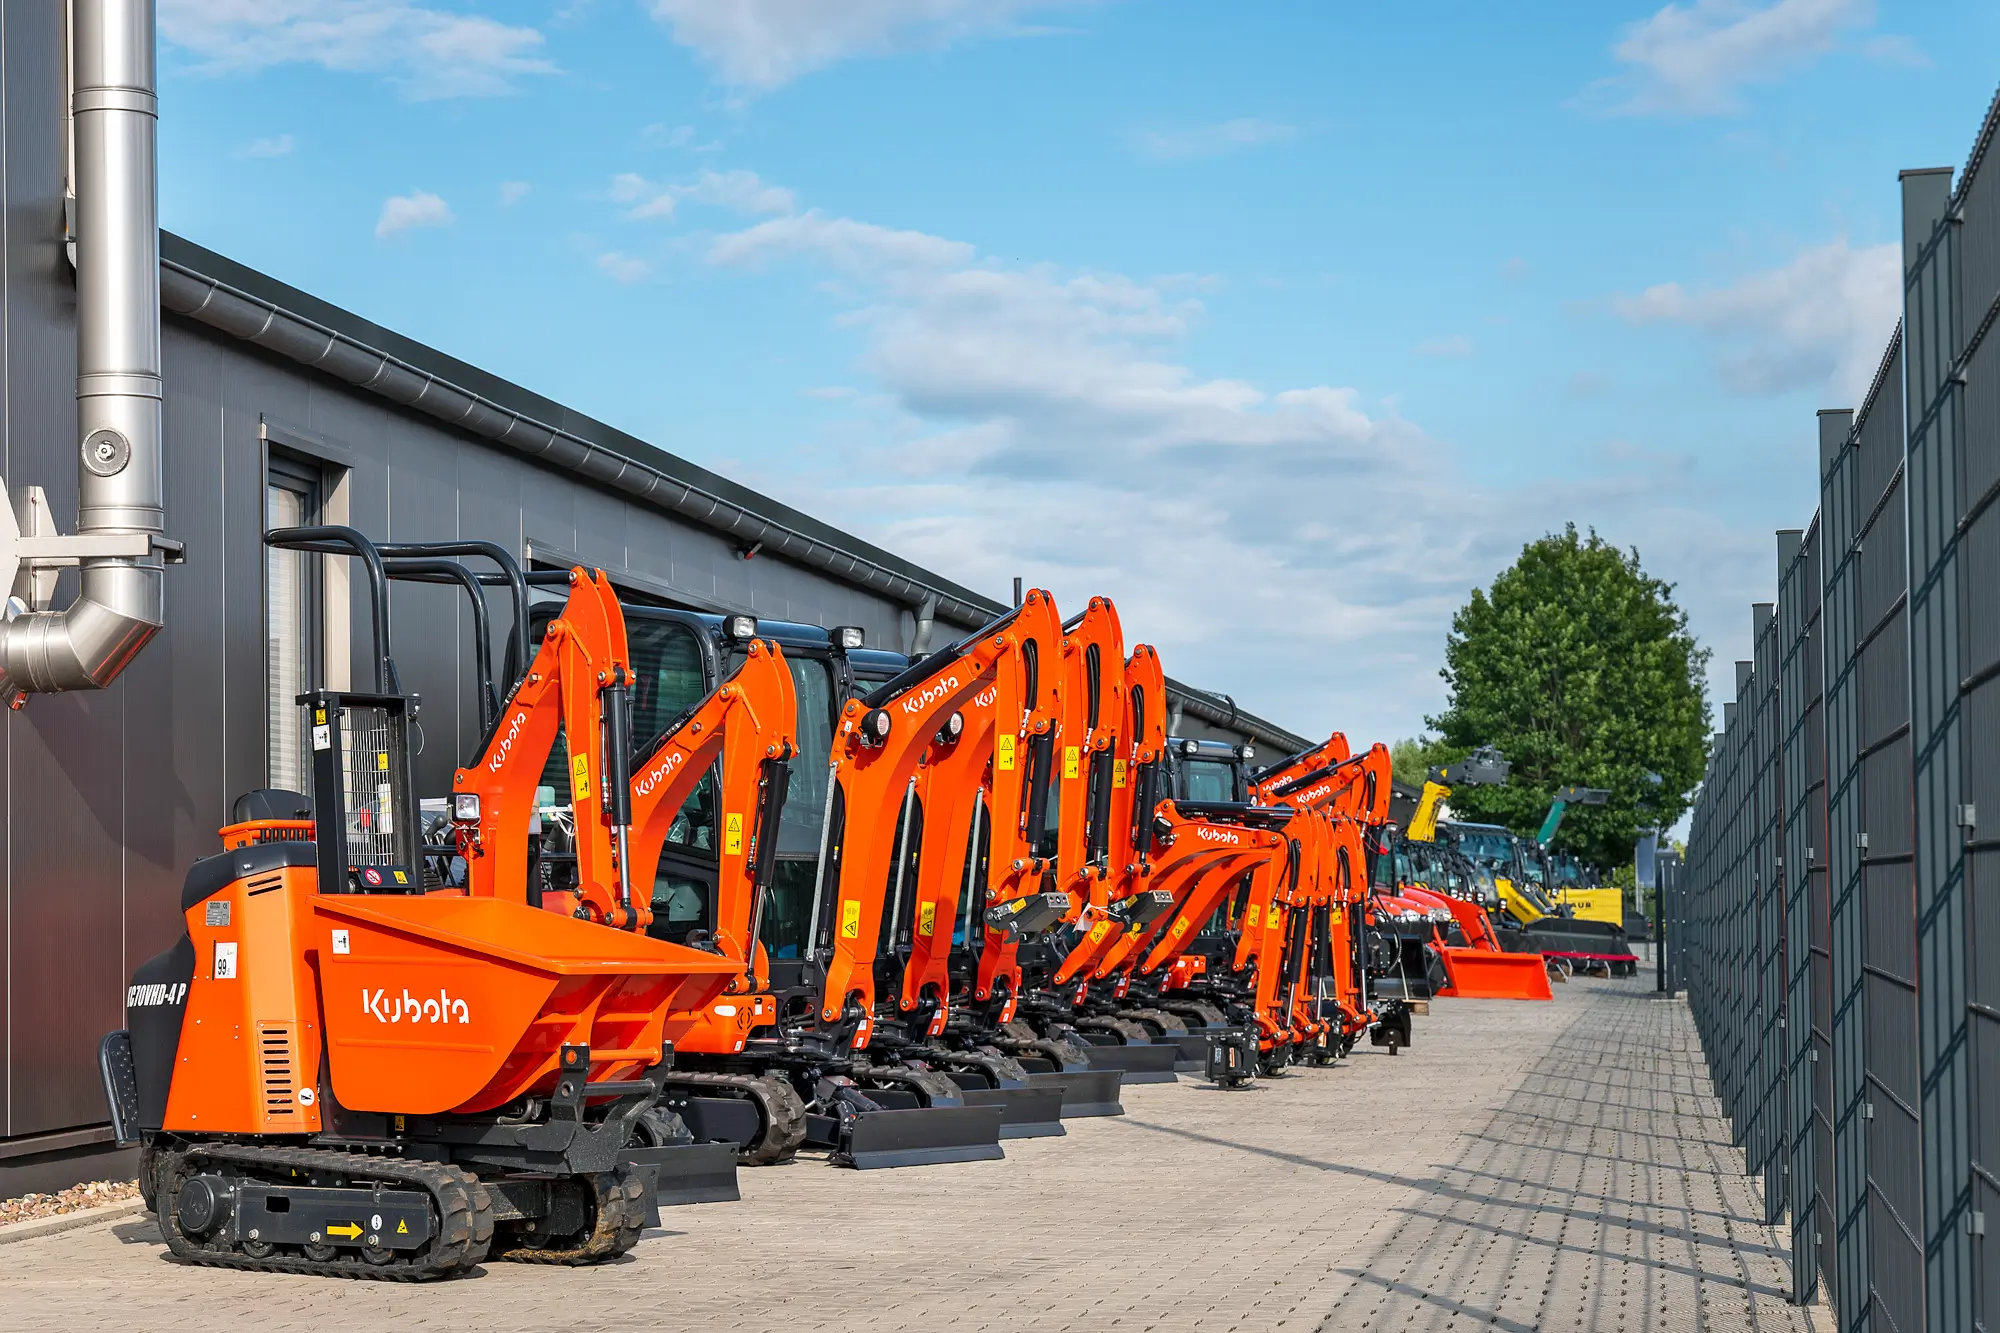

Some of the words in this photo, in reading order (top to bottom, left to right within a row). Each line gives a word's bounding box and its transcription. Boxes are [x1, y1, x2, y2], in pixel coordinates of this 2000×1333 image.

[902, 676, 959, 714] Kubota
[488, 712, 527, 773] Kubota
[634, 752, 683, 797] Kubota
[1296, 785, 1331, 804] Kubota
[1197, 827, 1239, 845] Kubota
[217, 958, 227, 976] 99
[176, 982, 187, 1005] P
[362, 988, 470, 1024] Kubota
